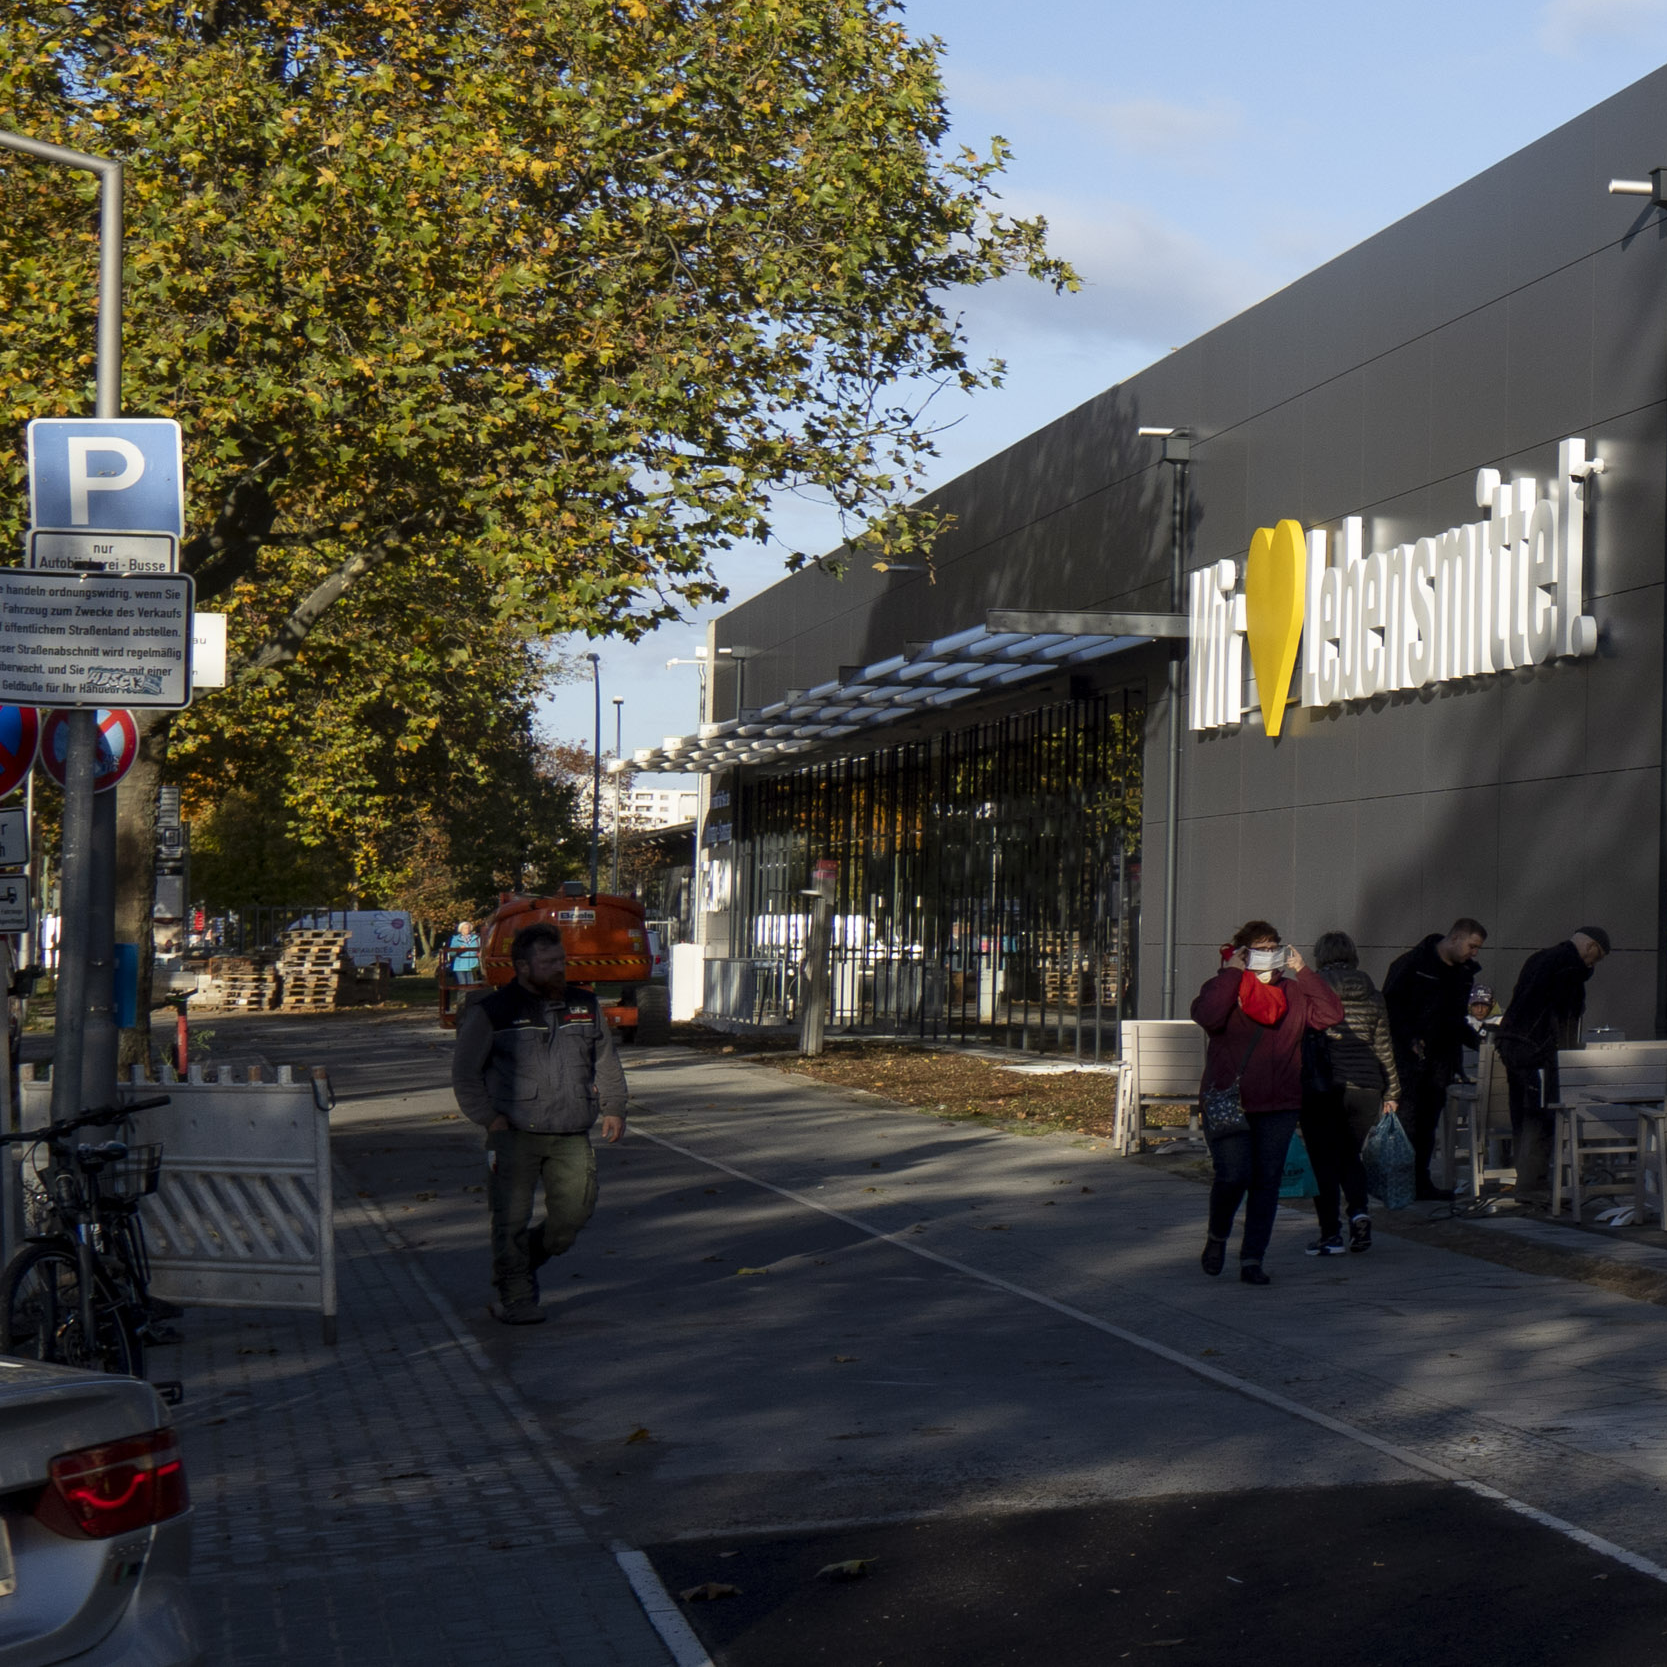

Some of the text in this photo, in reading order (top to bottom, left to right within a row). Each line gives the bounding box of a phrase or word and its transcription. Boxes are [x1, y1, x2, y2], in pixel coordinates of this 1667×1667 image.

[67, 436, 146, 526] P
[93, 543, 115, 555] nur
[128, 557, 166, 572] Busse
[6, 583, 46, 597] handeln
[135, 590, 162, 600] wenn
[165, 588, 181, 600] Sie
[2, 602, 182, 619] Fahrzeug zum Zwecke des Verkaufs
[4, 621, 66, 635] öffentlichem
[68, 624, 130, 637] Straßenland
[132, 625, 182, 638] abstellen.
[17, 643, 100, 657] Straßenabschnitt
[102, 646, 125, 658] wird
[126, 646, 182, 661] regelmäßig
[47, 664, 67, 675] und
[69, 664, 85, 675] Sie
[147, 665, 172, 677] einer
[2, 679, 44, 693] Geldbuße
[45, 682, 61, 694] für
[62, 683, 77, 694] Ihr
